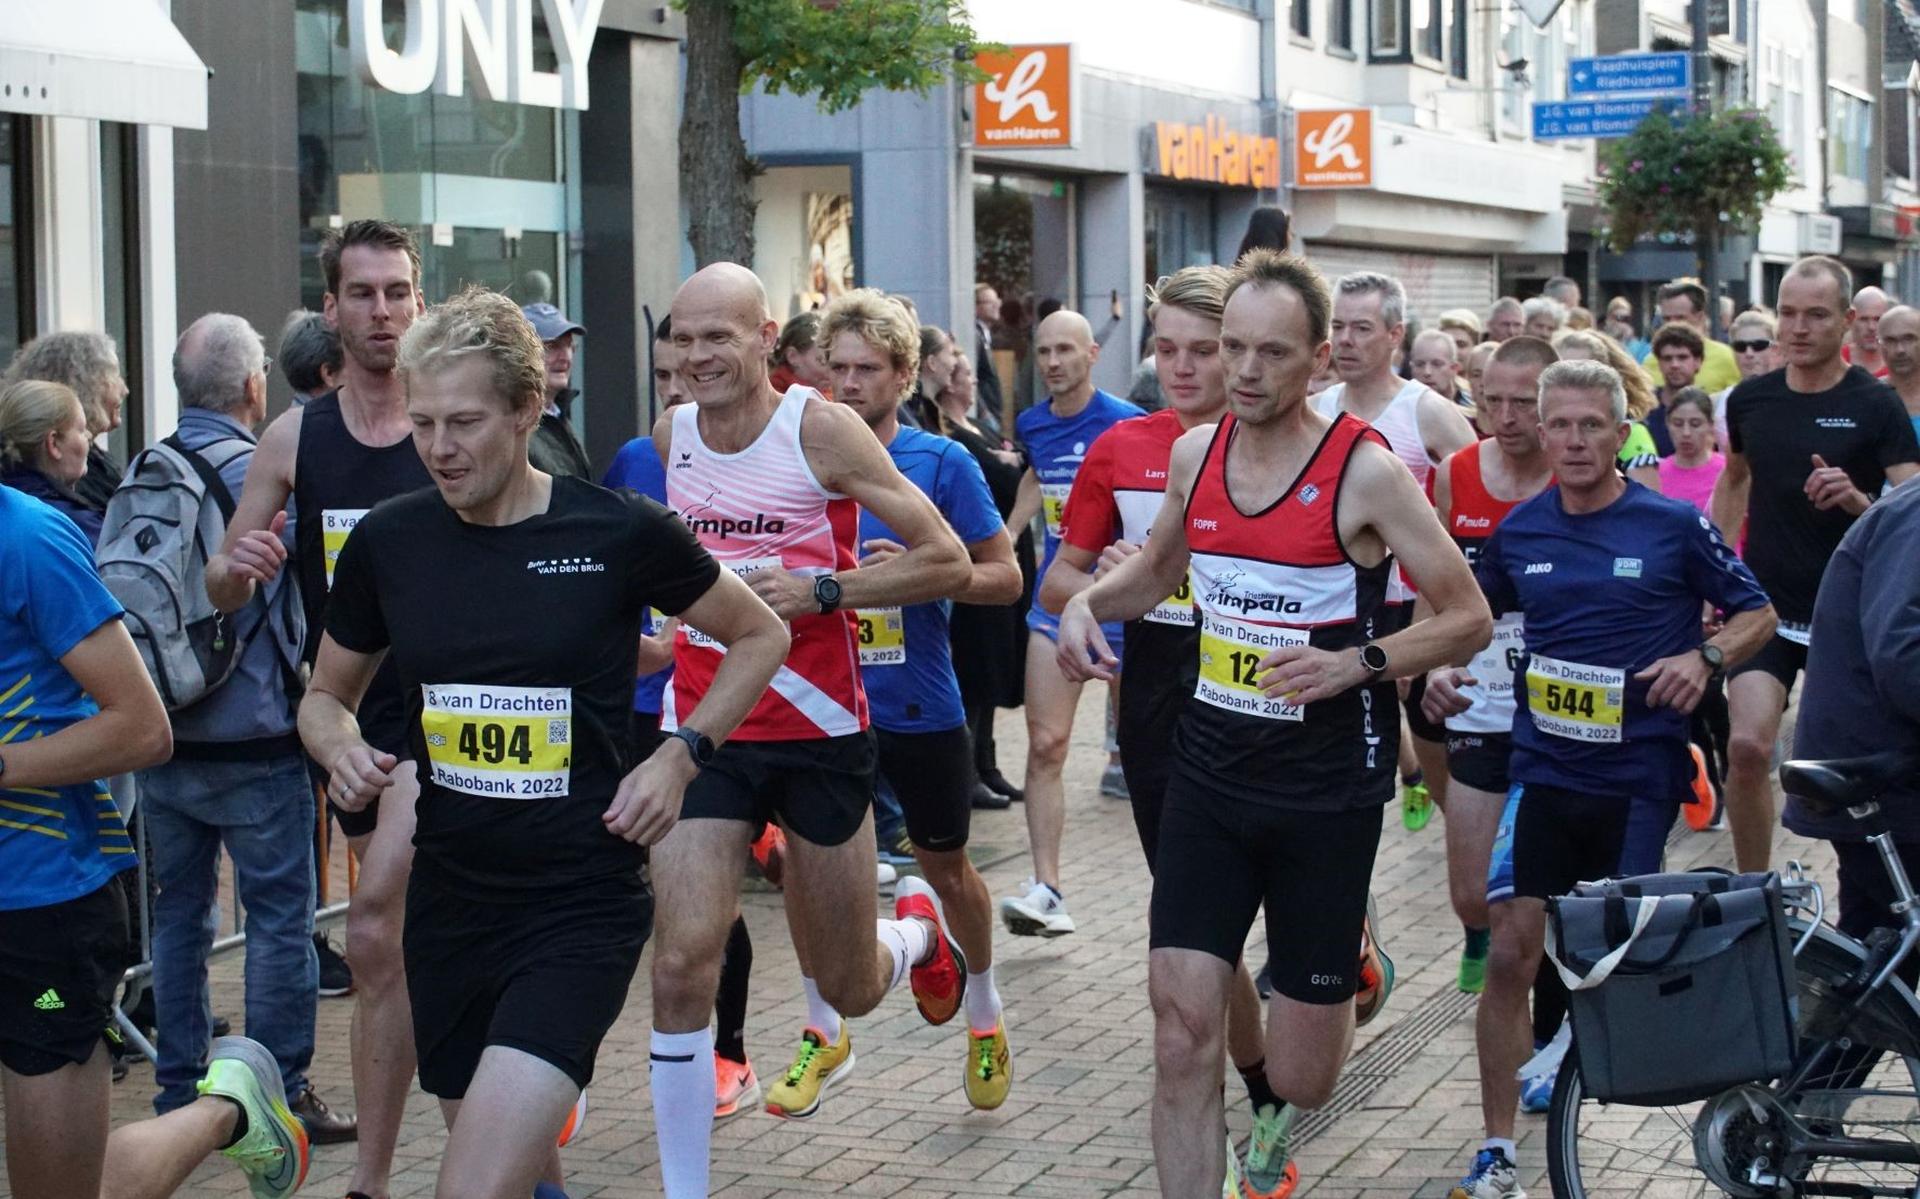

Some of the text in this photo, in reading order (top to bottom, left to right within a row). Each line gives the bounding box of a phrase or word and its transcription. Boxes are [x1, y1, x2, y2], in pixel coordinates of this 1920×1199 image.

[364, 0, 603, 111] ONLY
[1568, 106, 1590, 117] van
[1594, 102, 1651, 116] Blomstra
[984, 126, 1061, 140] vanHaren
[1566, 122, 1588, 132] van
[1157, 112, 1281, 188] vanHaren
[1145, 469, 1166, 478] Lars
[327, 515, 336, 528] 8
[1193, 518, 1218, 532] FOPPE
[538, 563, 604, 574] VAN DEN BRUG
[1525, 562, 1553, 575] JAKO
[1217, 588, 1302, 615] impala
[1148, 608, 1194, 622] Raboba
[1212, 622, 1233, 638] van
[872, 650, 902, 662] 2022
[1542, 663, 1559, 675] van
[1561, 666, 1621, 684] Drachten
[428, 690, 567, 711] 8 van Drachten
[1200, 683, 1299, 717] Rabobank 2022
[1546, 683, 1595, 719] 544
[1586, 727, 1617, 739] 2022
[458, 722, 533, 765] 494
[437, 768, 563, 794] Rabobank 2022
